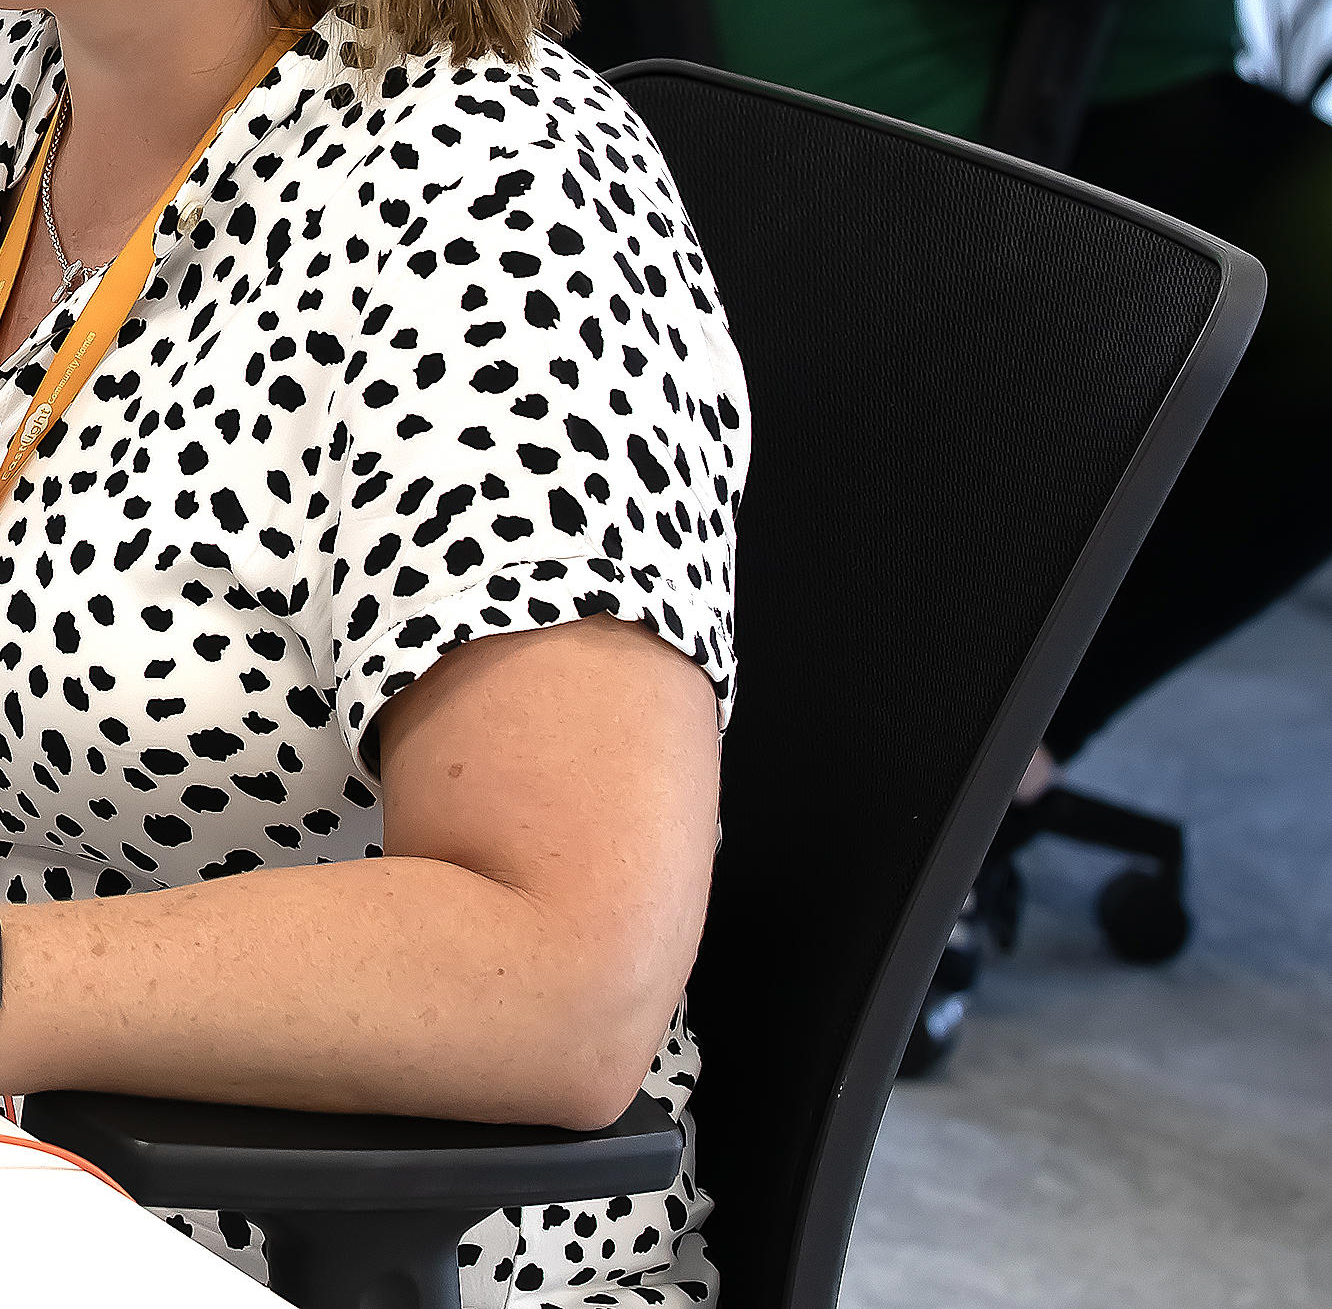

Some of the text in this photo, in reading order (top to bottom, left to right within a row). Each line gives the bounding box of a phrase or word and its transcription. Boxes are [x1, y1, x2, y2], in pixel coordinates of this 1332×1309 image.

[1, 331, 97, 482] Eastlight Community Homes
